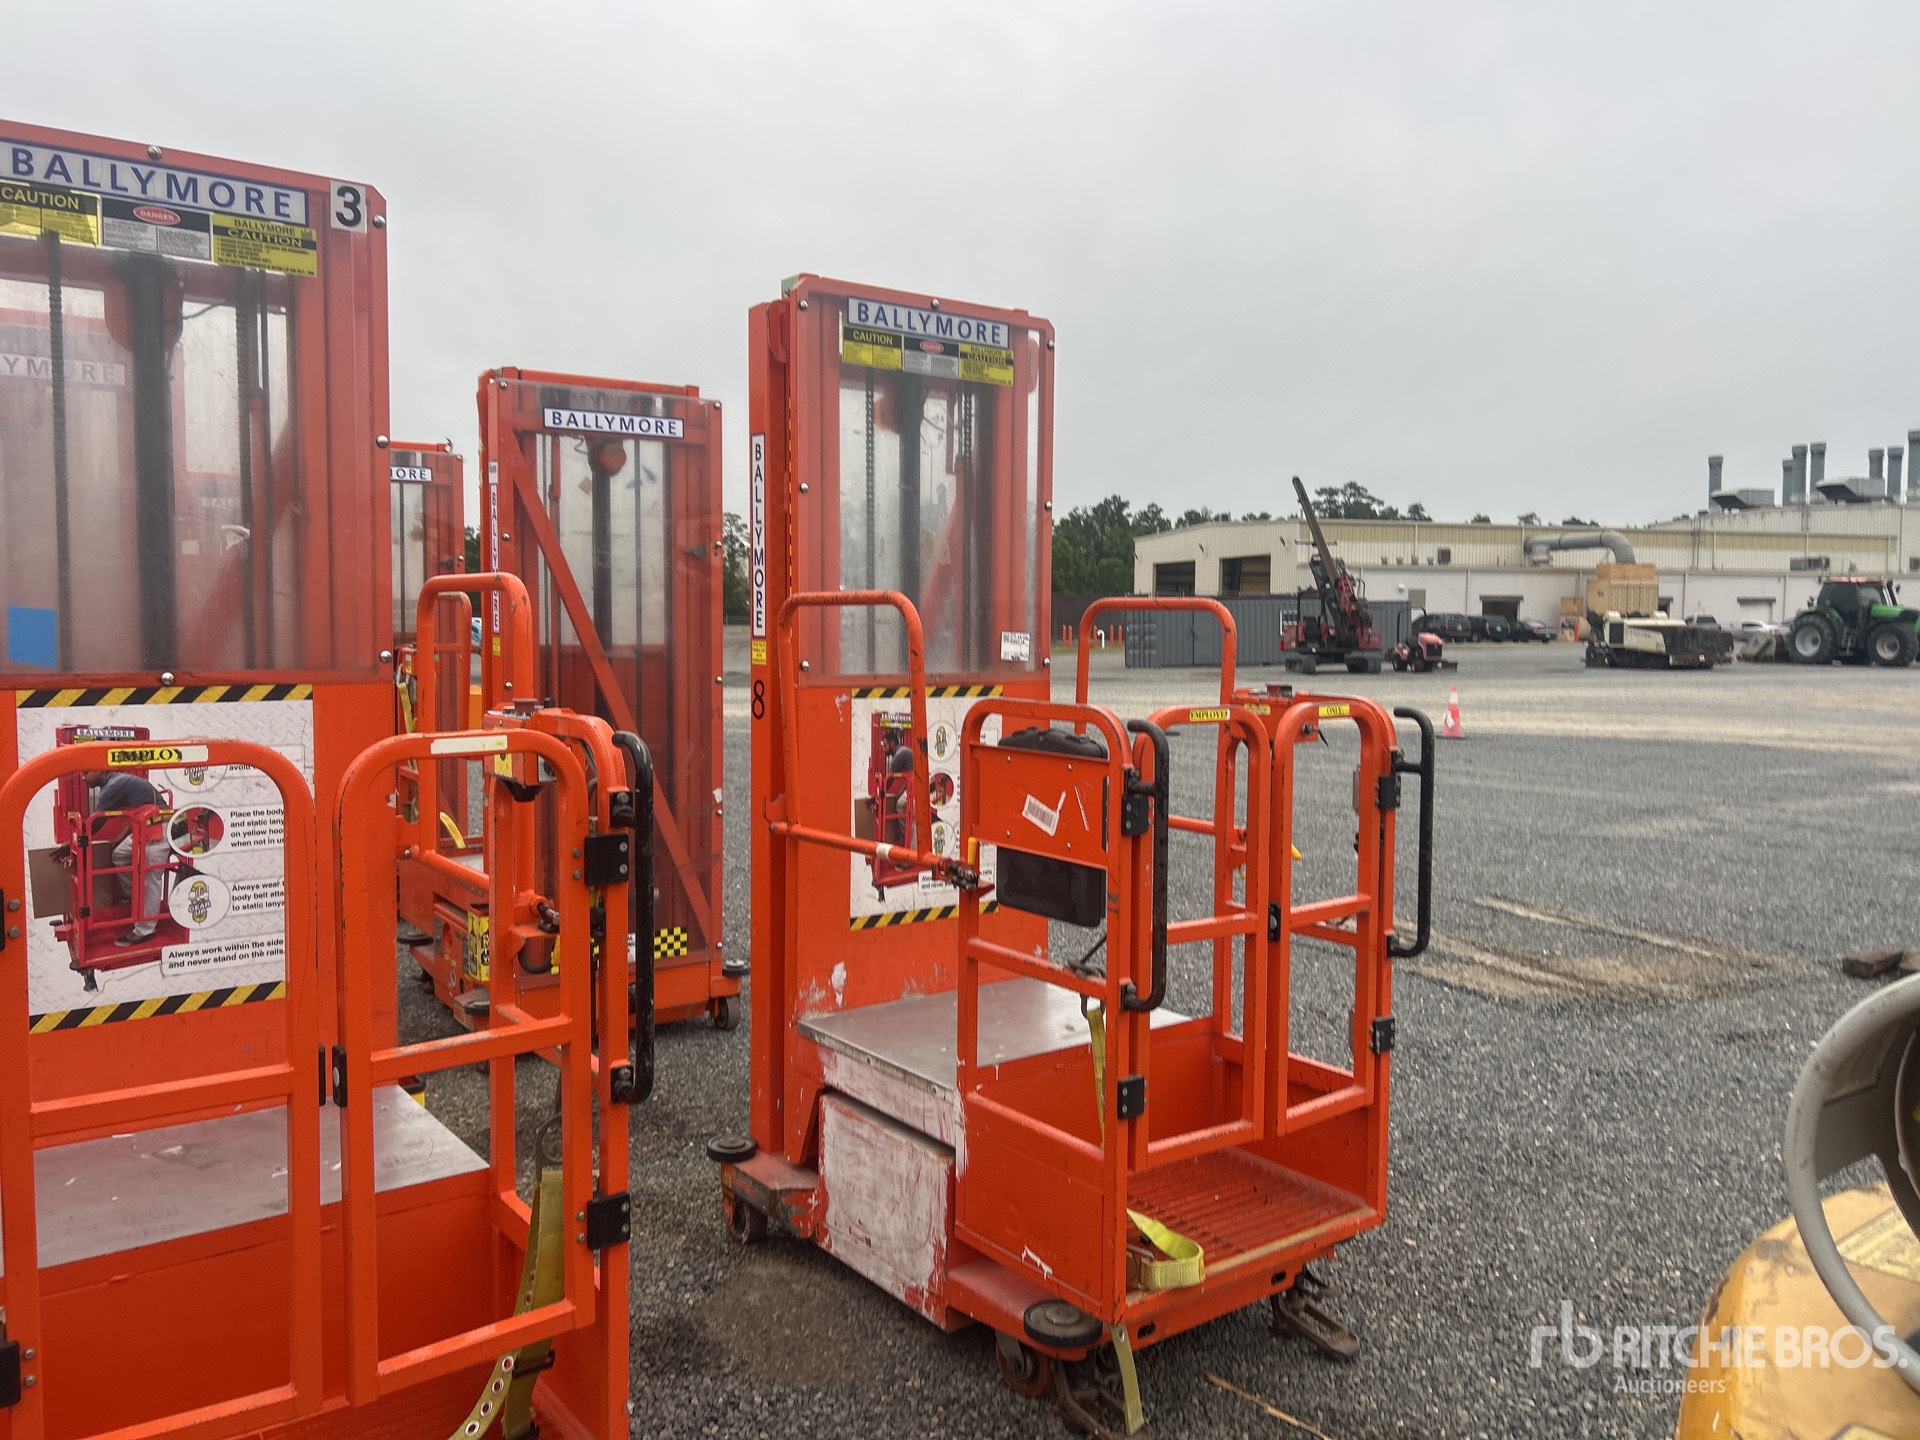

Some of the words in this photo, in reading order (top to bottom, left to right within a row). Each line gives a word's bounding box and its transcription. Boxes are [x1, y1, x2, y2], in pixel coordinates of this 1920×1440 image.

[12, 147, 291, 219] BALLYMORE
[1, 187, 79, 209] CAUTION
[335, 186, 362, 227] 3
[139, 209, 175, 222] DANGER
[234, 219, 295, 236] BALLYMORE
[228, 229, 303, 248] CAUTION
[858, 302, 1002, 344] BALLYMORE
[853, 330, 893, 345] CAUTION
[967, 353, 1006, 365] CAUTION
[552, 411, 677, 436] BALLYMORE
[754, 443, 764, 628] BALLYMORE
[752, 679, 765, 719] 8
[266, 808, 284, 817] body
[230, 840, 252, 848] when
[268, 836, 275, 844] in
[243, 829, 267, 838] yellow
[232, 884, 260, 893] Always
[232, 894, 251, 902] body
[253, 891, 268, 899] belt
[232, 903, 240, 911] to
[242, 902, 263, 910] static
[168, 950, 200, 959] Always
[202, 946, 222, 955] work
[224, 943, 250, 952] within
[252, 940, 265, 948] the
[267, 939, 284, 947] side
[168, 960, 185, 969] and
[187, 958, 212, 966] never
[213, 954, 237, 963] stand
[251, 950, 265, 958] the
